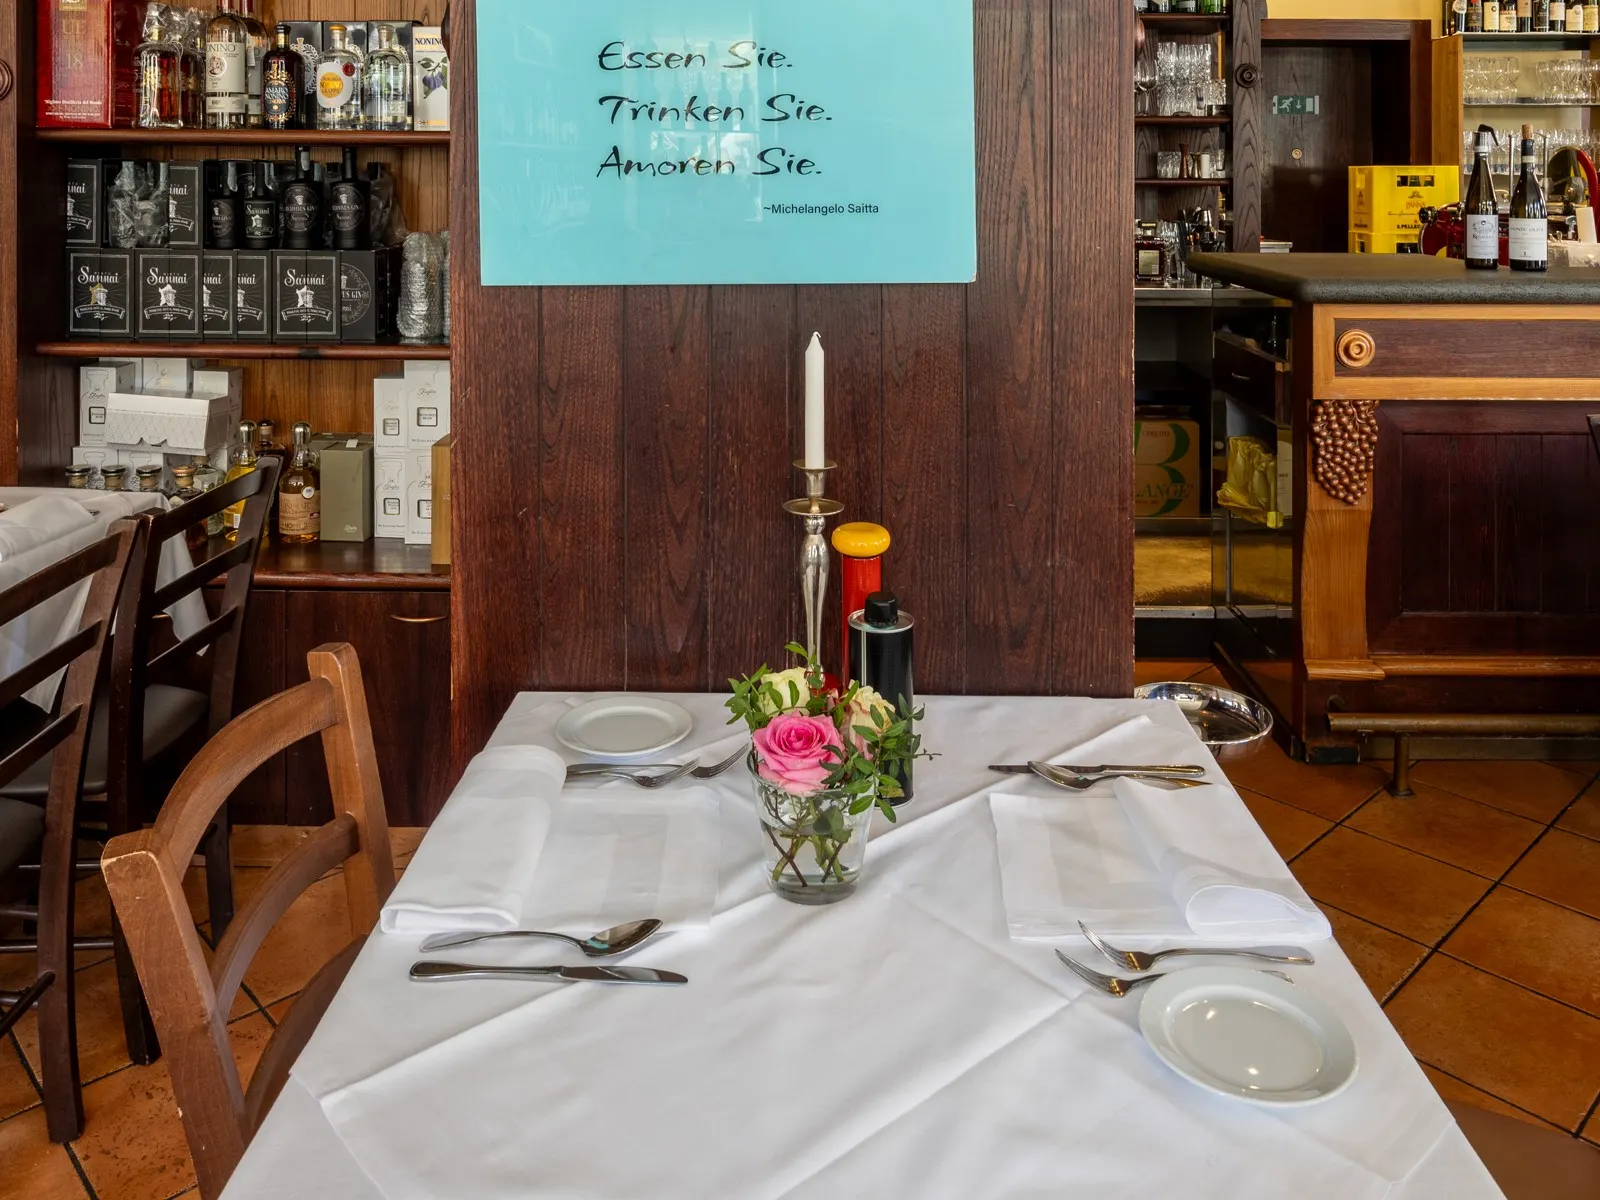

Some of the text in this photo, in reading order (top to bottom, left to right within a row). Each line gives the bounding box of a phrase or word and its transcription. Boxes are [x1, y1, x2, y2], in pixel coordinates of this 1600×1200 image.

[598, 41, 793, 70] Essen Sie.
[598, 93, 833, 124] Trinken Sie.
[596, 146, 822, 180] Amoren Sie.
[763, 203, 879, 216] ~Michelangelo Saitta
[77, 266, 119, 284] Sannai
[147, 267, 187, 285] Sannai
[284, 268, 325, 287] Sannai
